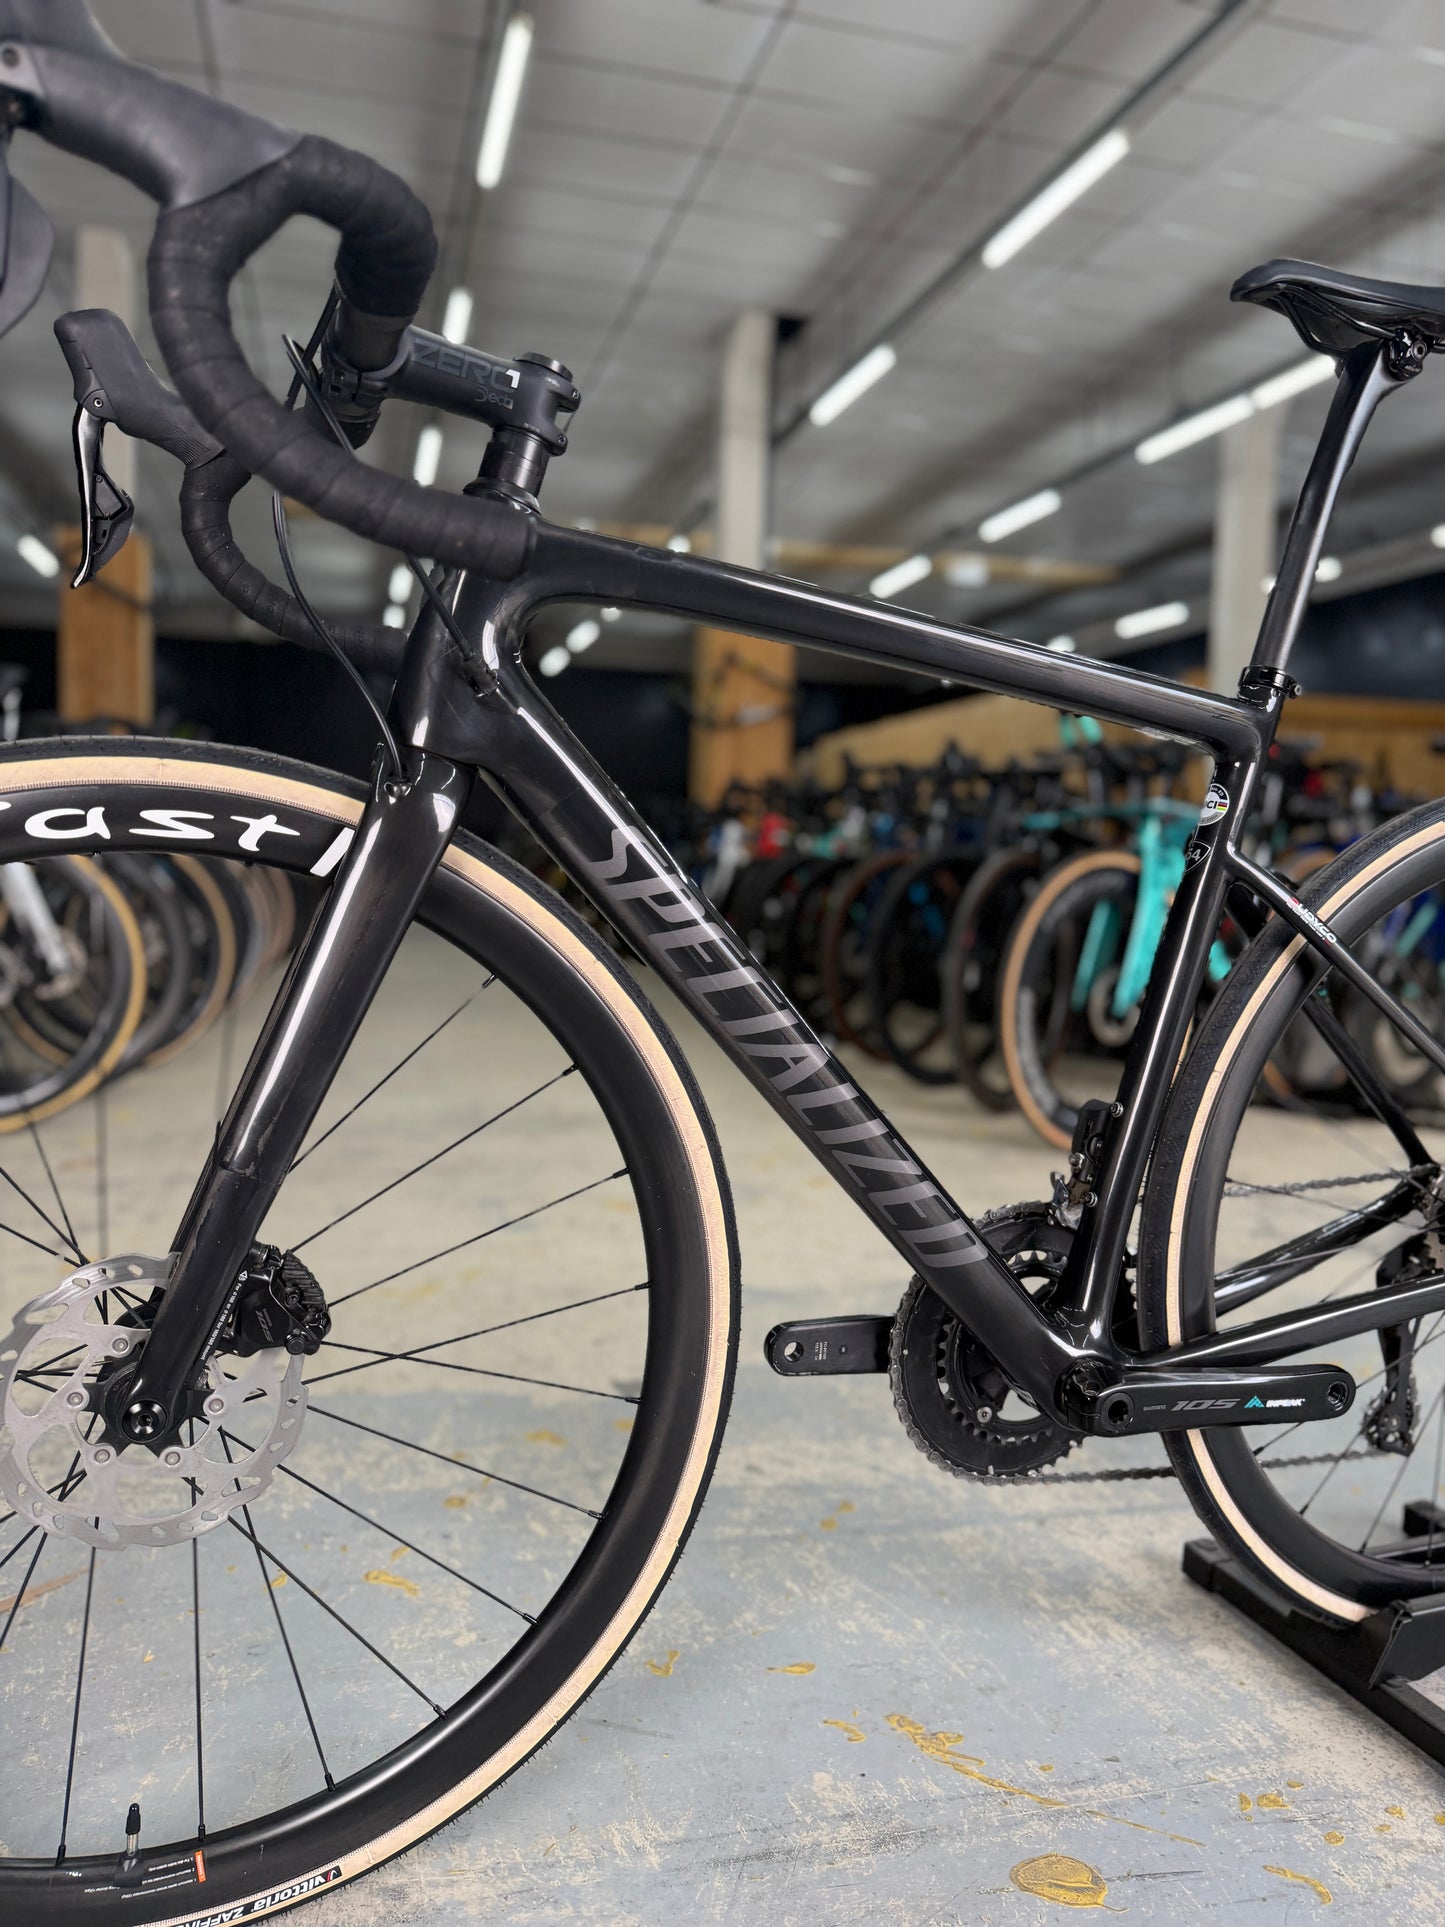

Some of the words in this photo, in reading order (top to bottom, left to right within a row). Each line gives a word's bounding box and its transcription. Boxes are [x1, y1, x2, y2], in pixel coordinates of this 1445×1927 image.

[0, 800, 301, 852] ast
[589, 826, 989, 1268] SPECIALIZED
[1170, 1398, 1241, 1411] 105
[253, 1875, 326, 1912] vittoria
[174, 1905, 245, 1927] ZAFFI
